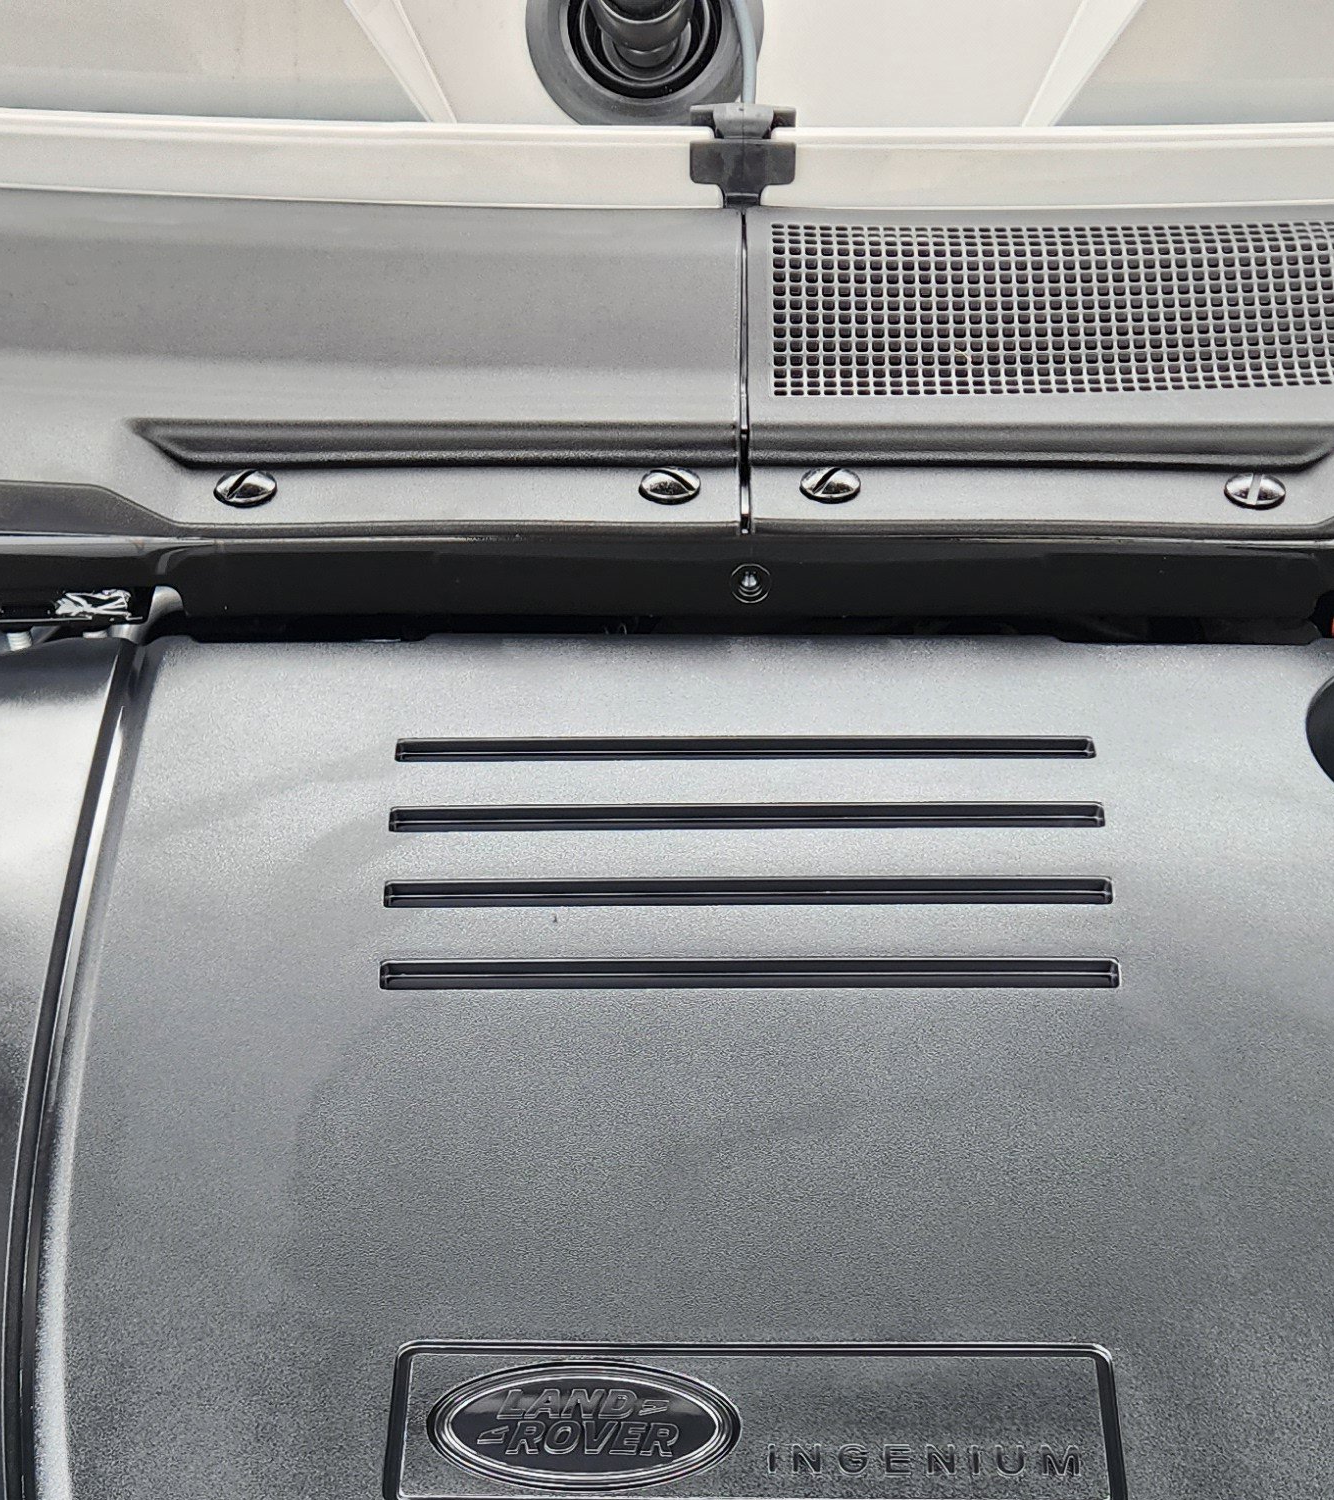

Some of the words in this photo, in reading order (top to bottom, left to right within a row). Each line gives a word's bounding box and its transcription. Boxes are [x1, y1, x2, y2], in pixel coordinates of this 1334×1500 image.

[496, 1388, 638, 1419] LAND
[505, 1420, 680, 1457] ROVER
[766, 1443, 1083, 1478] INGENIUM
